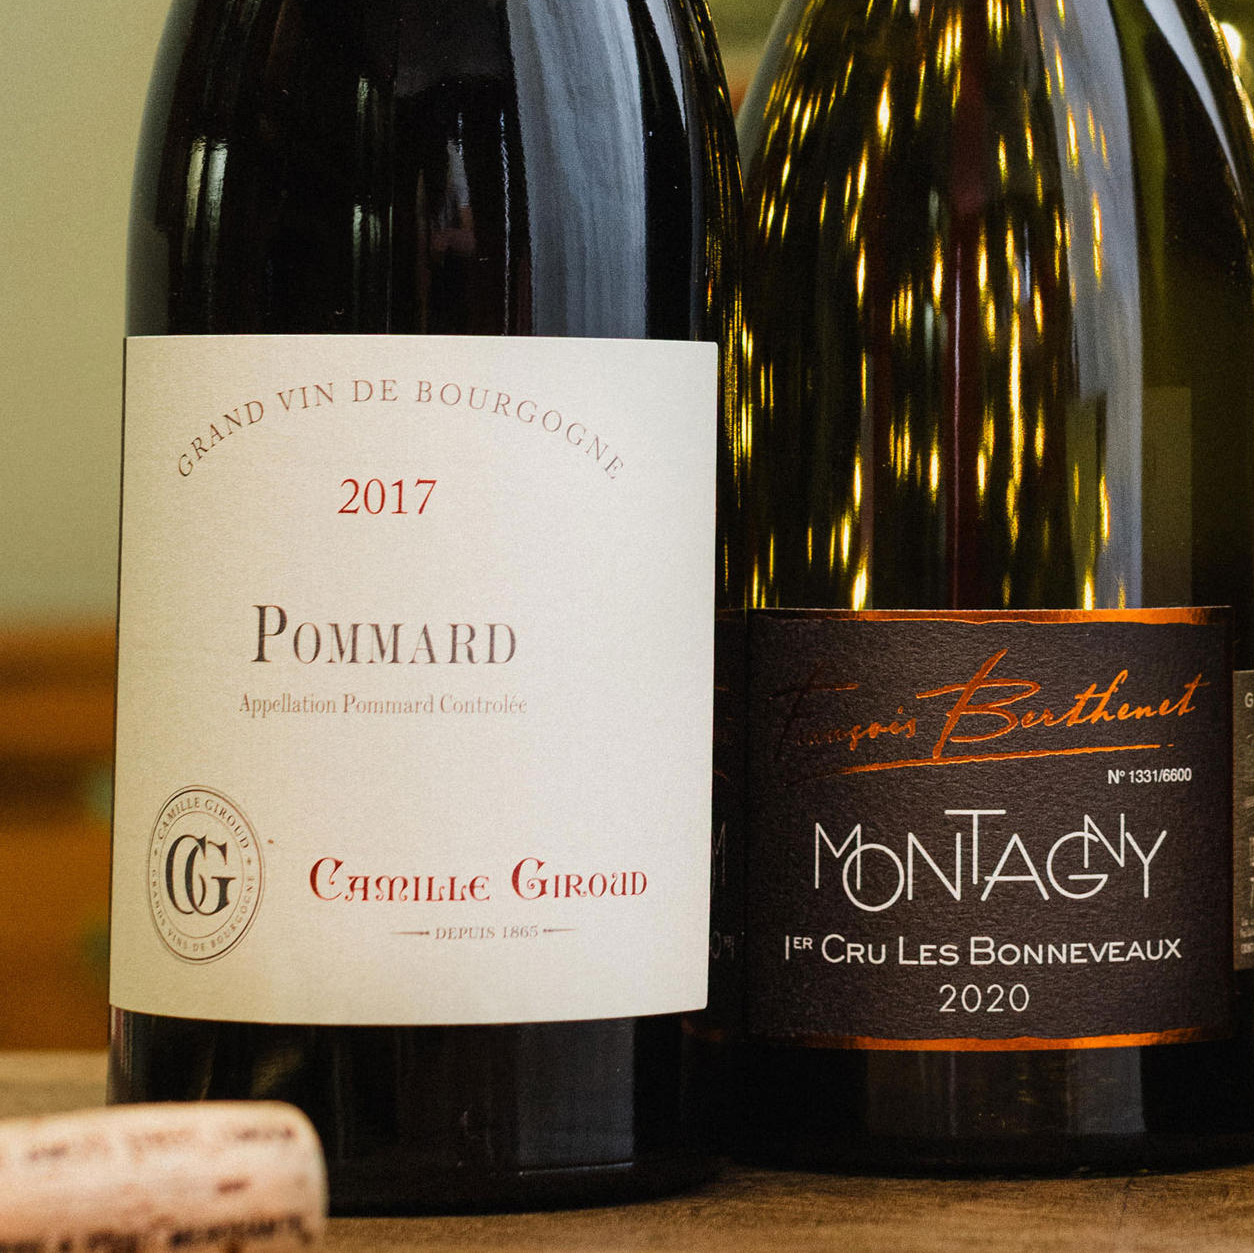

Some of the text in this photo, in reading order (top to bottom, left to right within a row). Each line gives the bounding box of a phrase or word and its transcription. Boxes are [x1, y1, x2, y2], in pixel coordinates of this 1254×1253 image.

[176, 378, 624, 484] GRAND VIN DE BOURGOGNE
[337, 478, 438, 516] 2017
[250, 604, 518, 665] POMMARD
[238, 692, 338, 720] Appellation
[342, 692, 434, 716] Pommard
[1126, 767, 1193, 784] 1331/6600
[814, 808, 1168, 912] MONTAGNY
[308, 856, 650, 902] CAMILLE GIROUD
[434, 924, 542, 942] DEPUIS 1865
[820, 932, 888, 966] CRU
[898, 935, 960, 966] LES
[968, 934, 1182, 966] BONNEVEAUX
[938, 983, 1031, 1014] 2020
